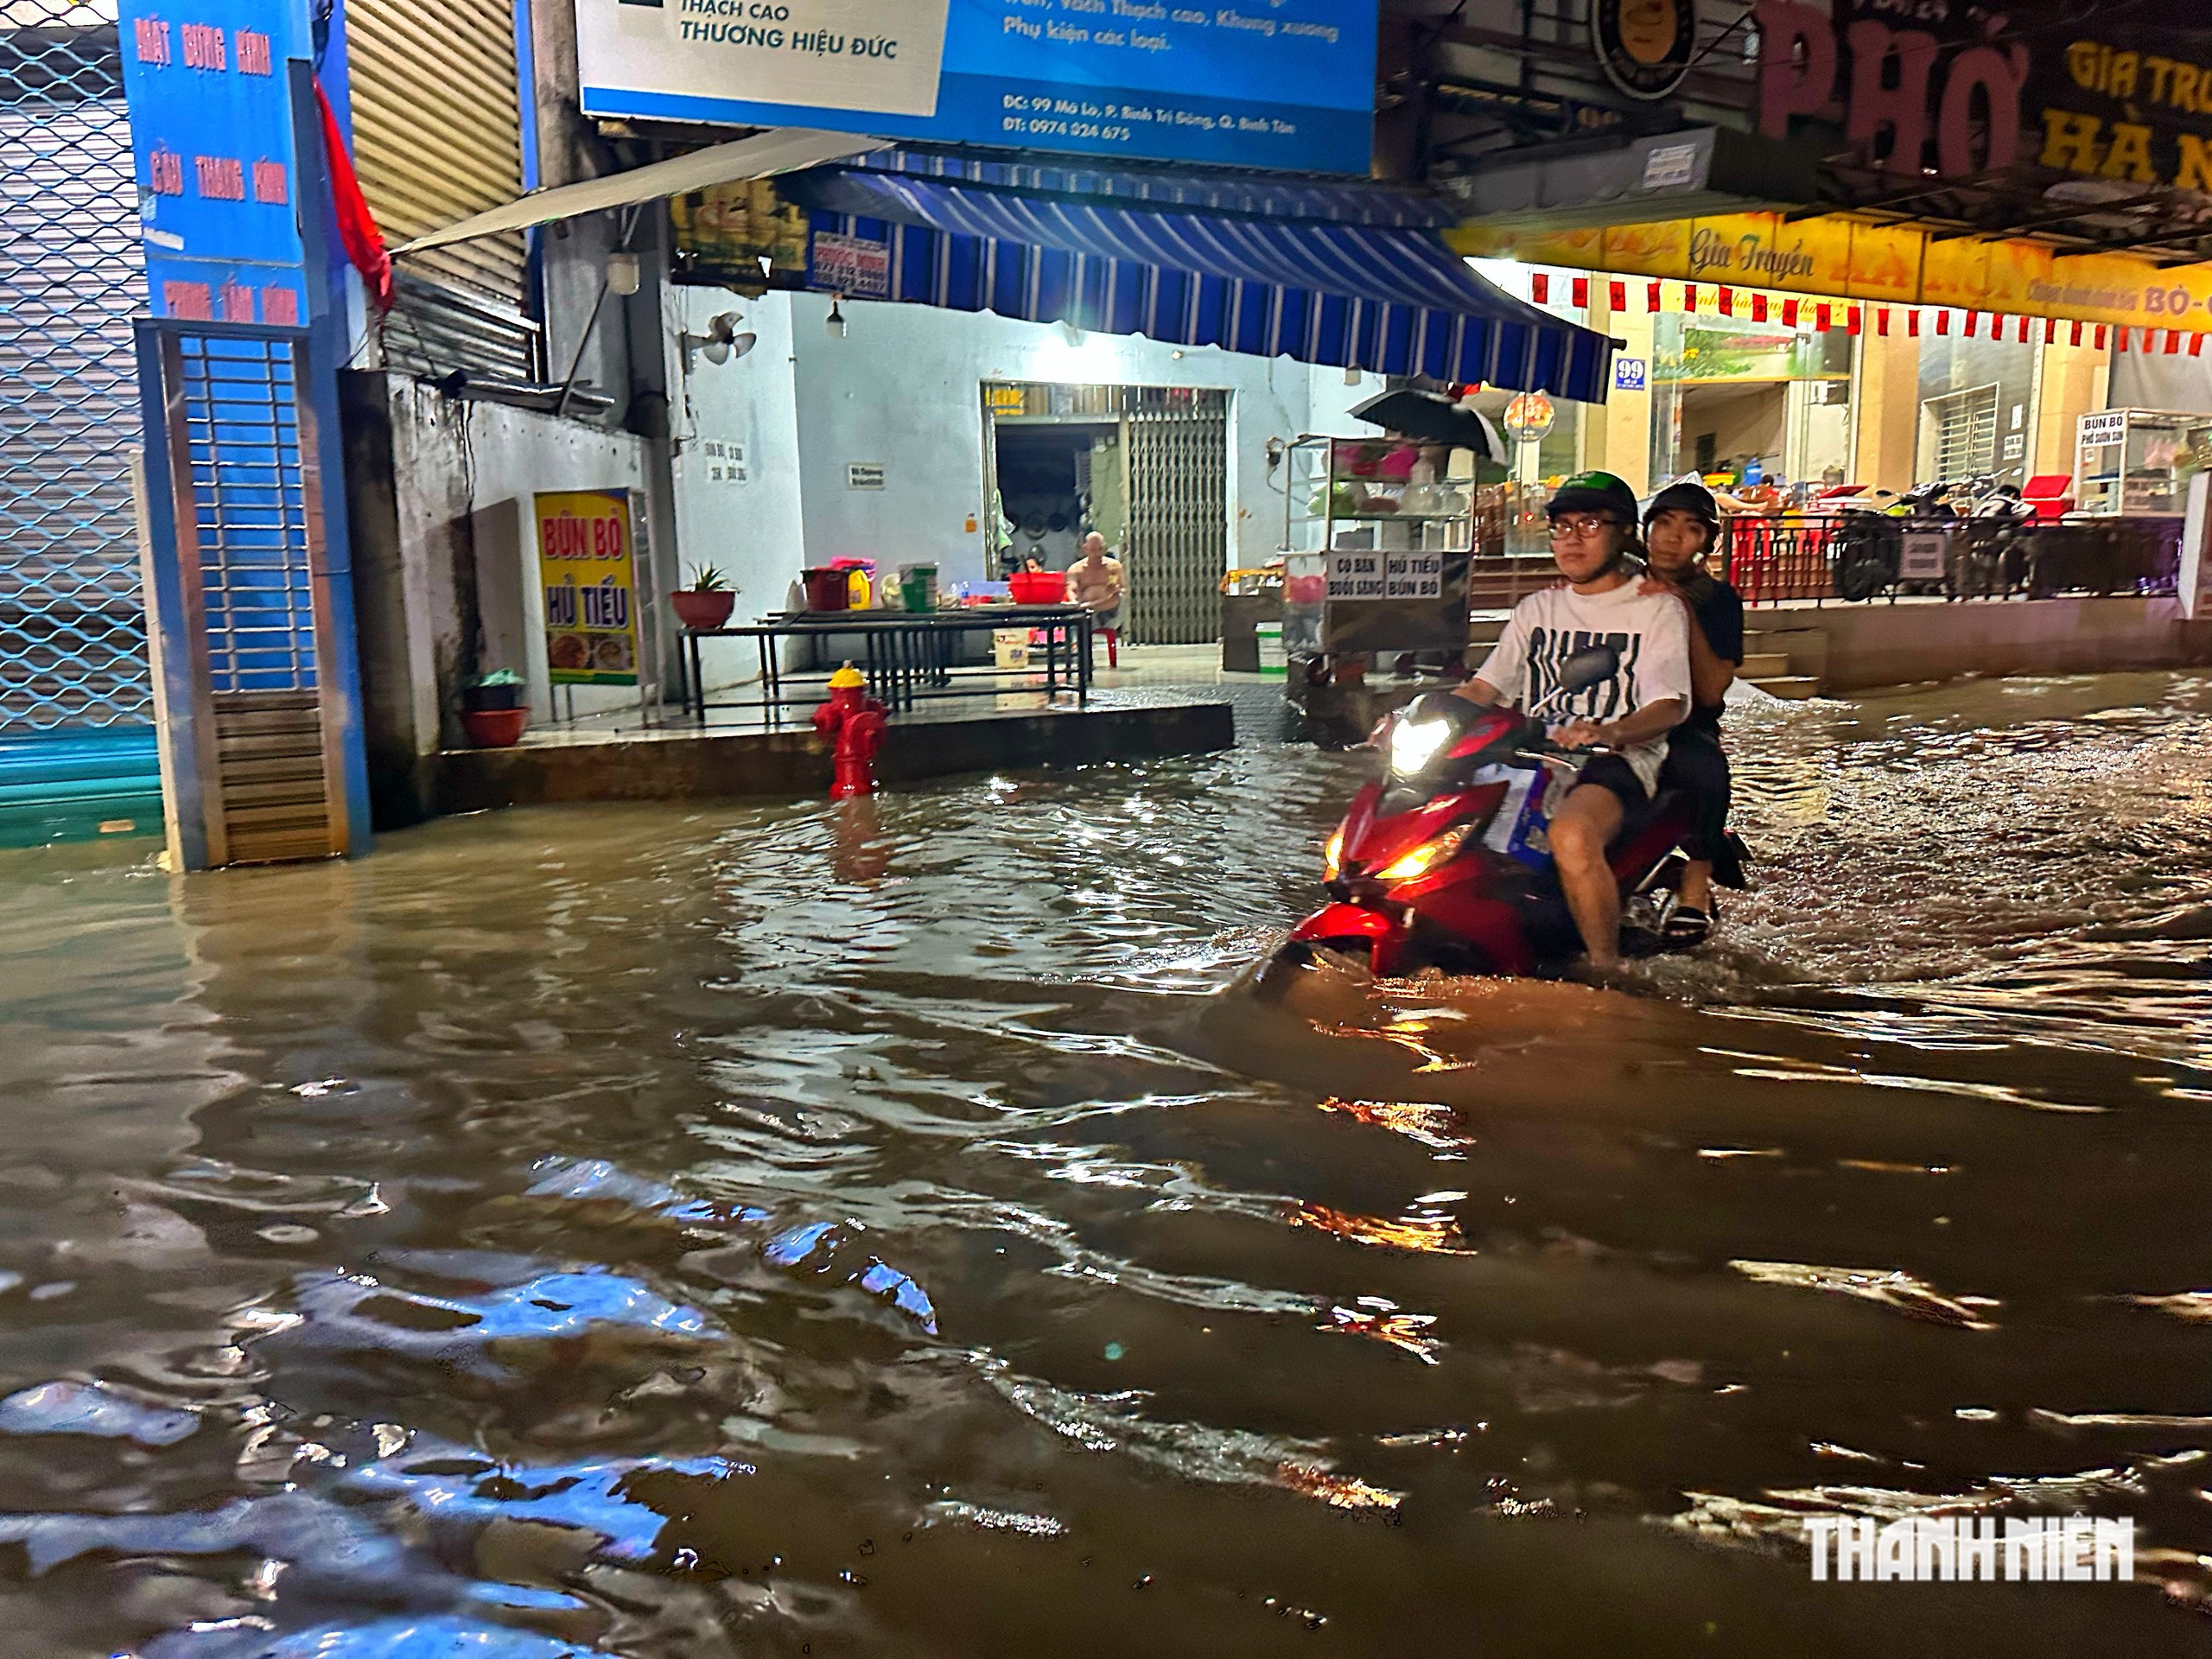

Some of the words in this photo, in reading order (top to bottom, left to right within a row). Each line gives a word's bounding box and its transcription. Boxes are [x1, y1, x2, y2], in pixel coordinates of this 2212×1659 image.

[681, 0, 742, 18] THẠCH
[749, 3, 789, 21] CAO
[1216, 9, 1276, 37] Khung
[680, 20, 785, 48] THƯƠNG
[791, 29, 845, 57] HIỆU
[850, 34, 899, 60] ĐỨC
[1046, 19, 1089, 45] kiện
[1093, 29, 1125, 46] các
[2066, 40, 2139, 97] GIA
[1003, 94, 1029, 110] ĐC:
[1031, 97, 1052, 112] 99
[1002, 117, 1027, 131] ĐT:
[1029, 118, 1067, 135] 0974
[2040, 104, 2157, 183] HÀ
[1688, 228, 1732, 275] Gia
[1618, 359, 1643, 379] 99
[543, 509, 591, 560] BÚN
[593, 507, 623, 561] BÒ
[582, 574, 628, 629] TIẾU
